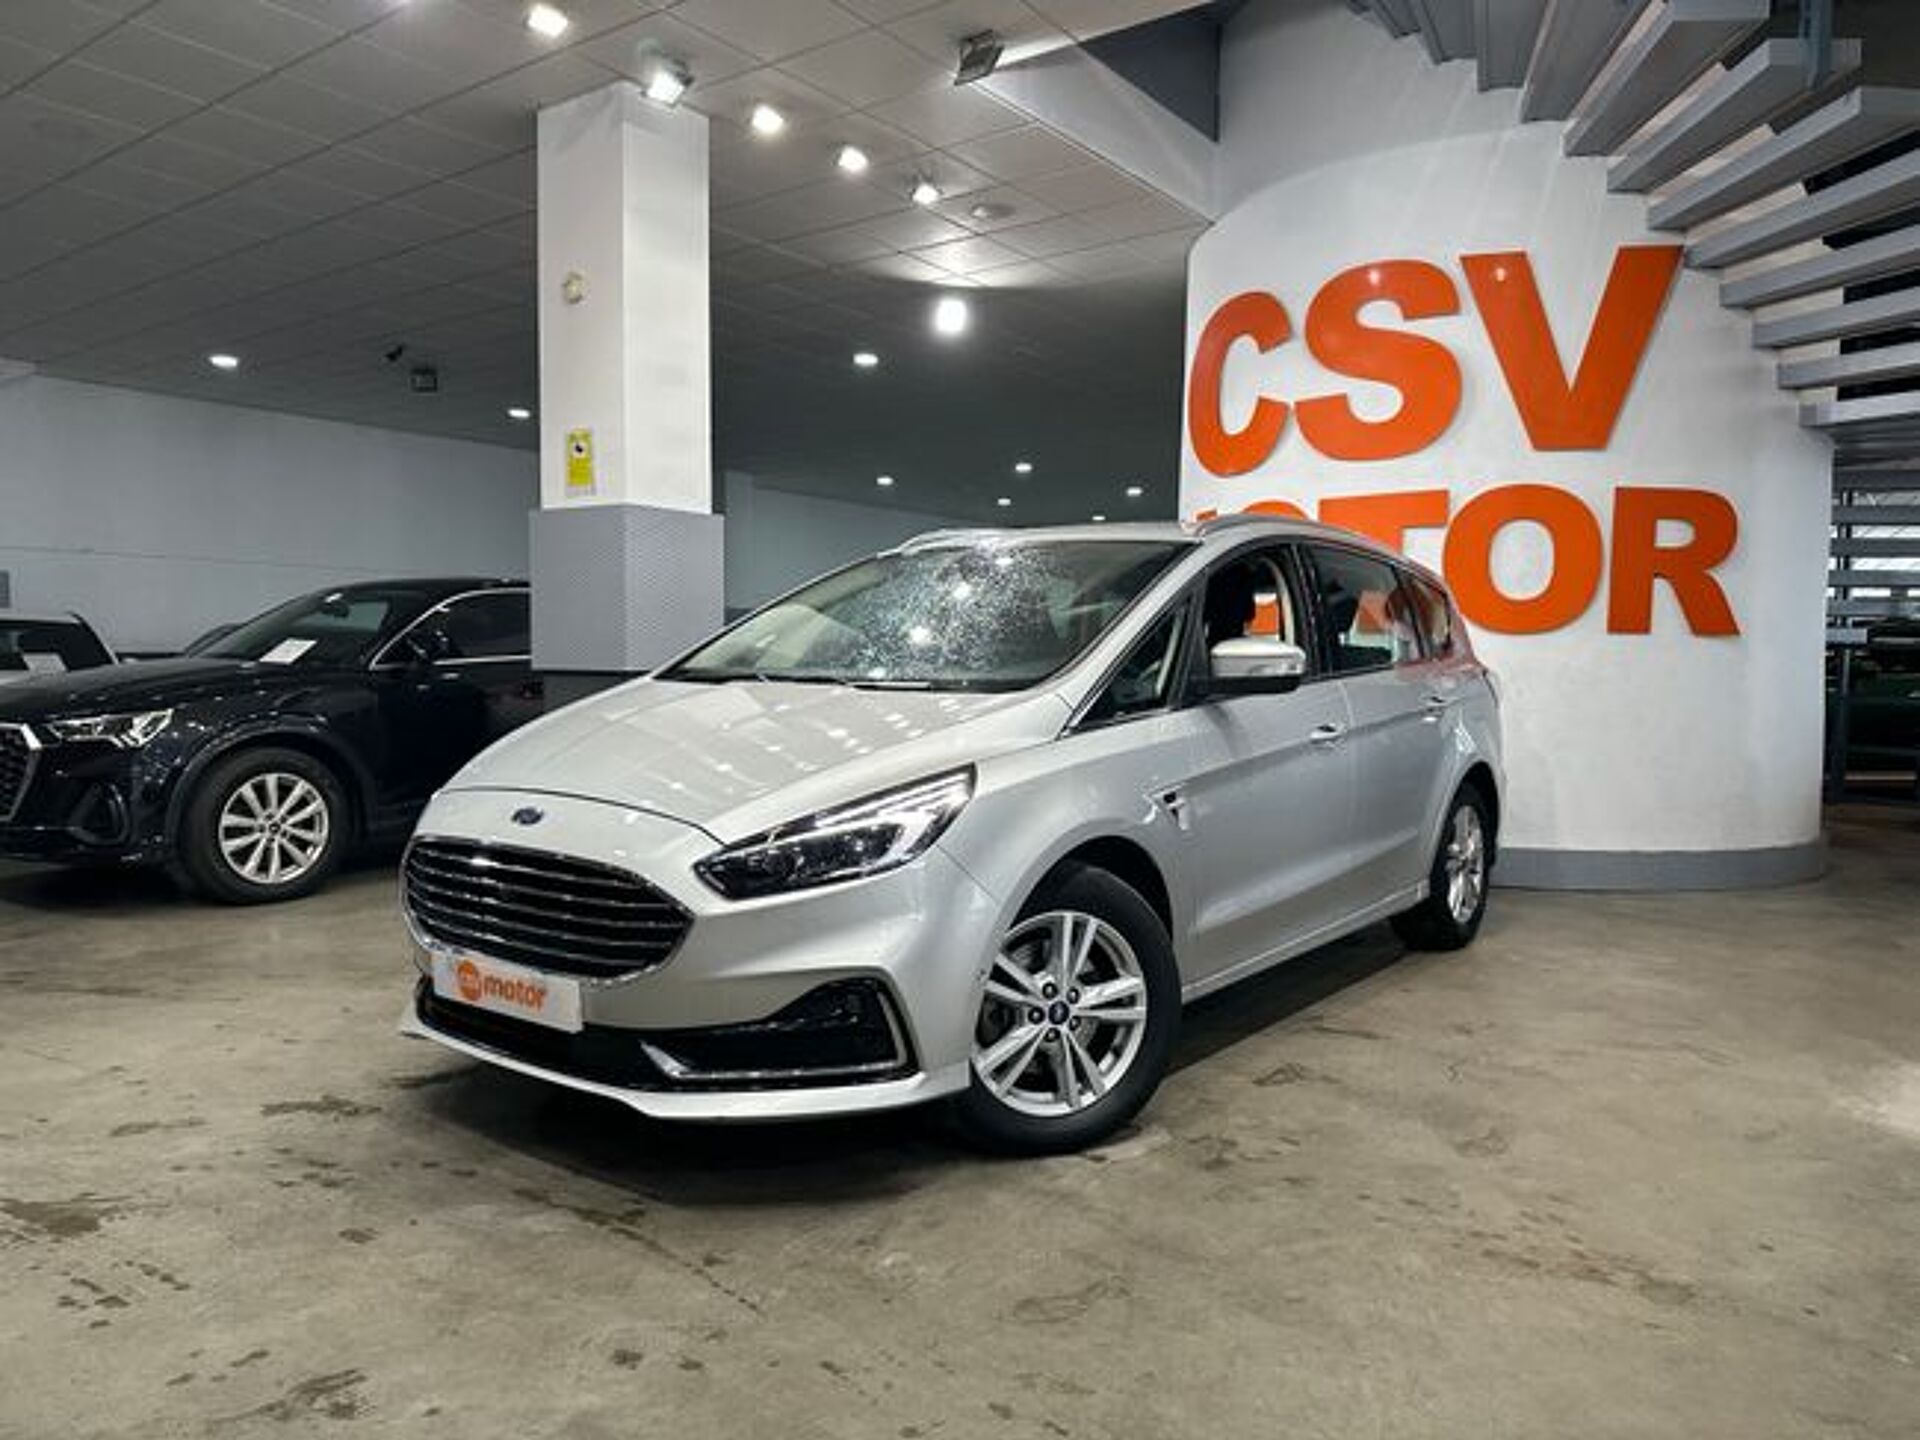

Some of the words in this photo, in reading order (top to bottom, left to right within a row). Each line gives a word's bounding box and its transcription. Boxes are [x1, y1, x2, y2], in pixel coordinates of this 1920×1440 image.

[1188, 245, 1684, 477] CSV
[1196, 483, 1740, 636] TOR
[483, 975, 546, 1012] motor
